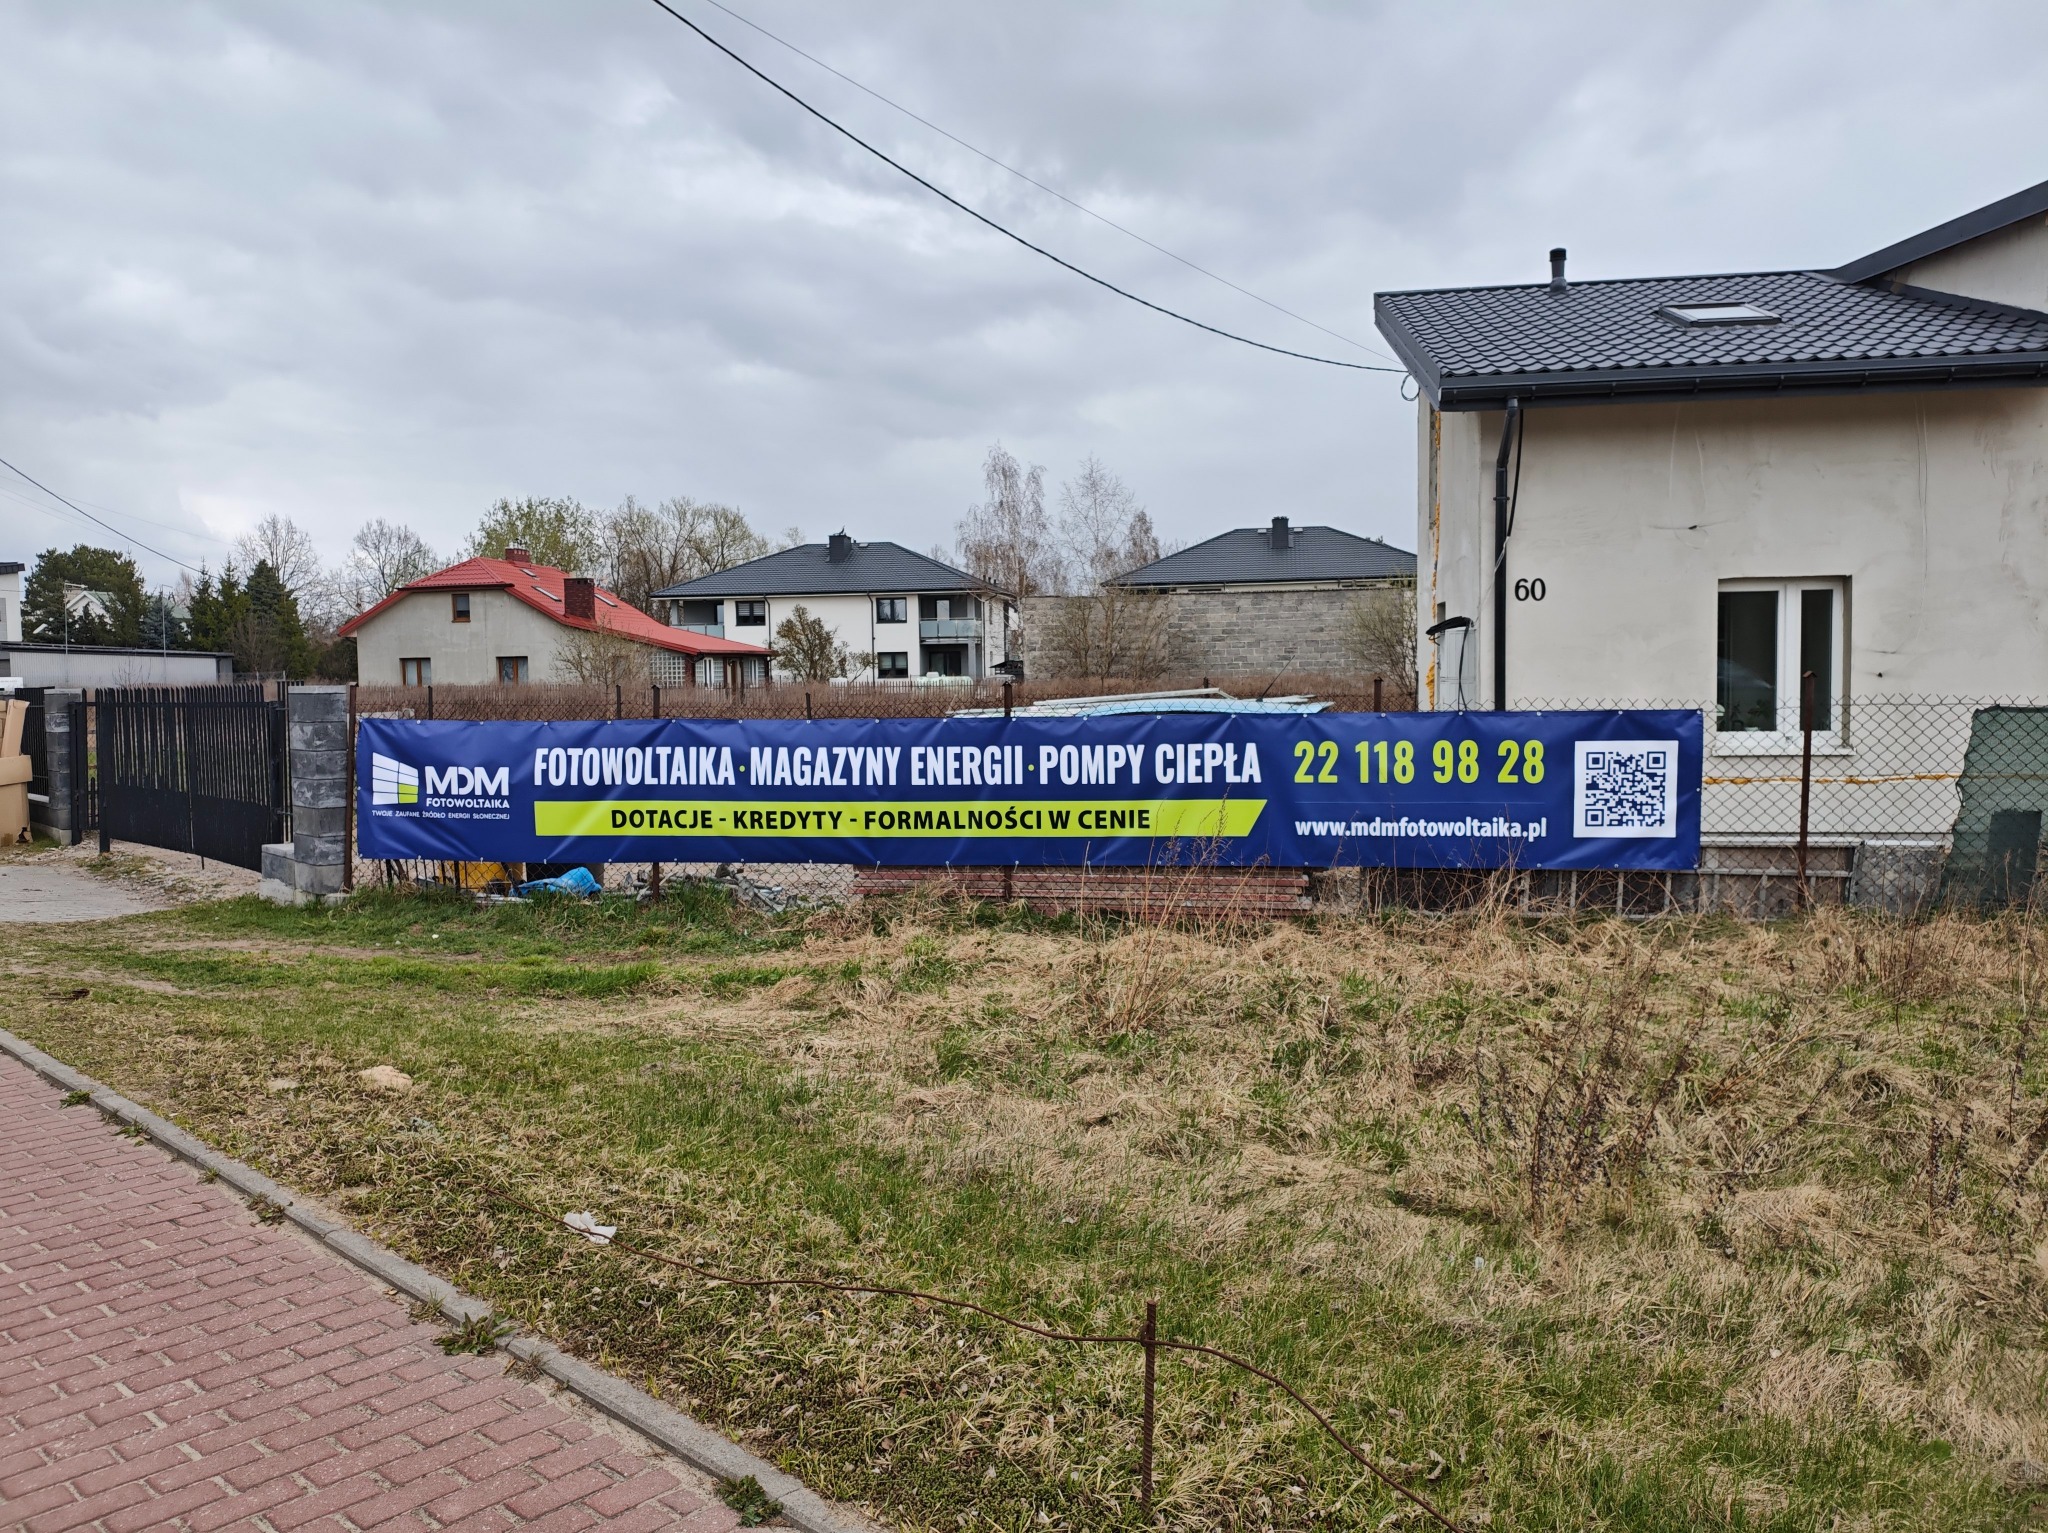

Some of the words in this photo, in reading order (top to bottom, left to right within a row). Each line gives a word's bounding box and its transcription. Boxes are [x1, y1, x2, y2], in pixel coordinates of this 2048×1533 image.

[1514, 577, 1546, 602] 60
[533, 746, 736, 787] FOTOWOLTAIKA
[750, 746, 901, 787] MAGAZYNY
[911, 745, 1023, 786] ENERGII
[1039, 744, 1145, 785] POMPY
[1155, 742, 1262, 784] CIEPŁA
[1293, 740, 1339, 784] 22
[1354, 740, 1415, 784] 118
[1432, 739, 1479, 784] 98
[1497, 739, 1545, 784] 28
[424, 765, 510, 796] MDM
[394, 810, 420, 818] ZAUFANE
[472, 812, 510, 820] SŁONECZNEJ
[426, 797, 510, 809] FOTOWOLTAIKA
[611, 809, 713, 829] DOTACJE
[733, 810, 843, 830] KREDYTY
[864, 806, 1042, 830] FORMALNOŚCI
[1047, 810, 1071, 830] W
[1077, 809, 1150, 829] CENIE
[1294, 816, 1547, 842] www.mdmfotowoltaika.pl
